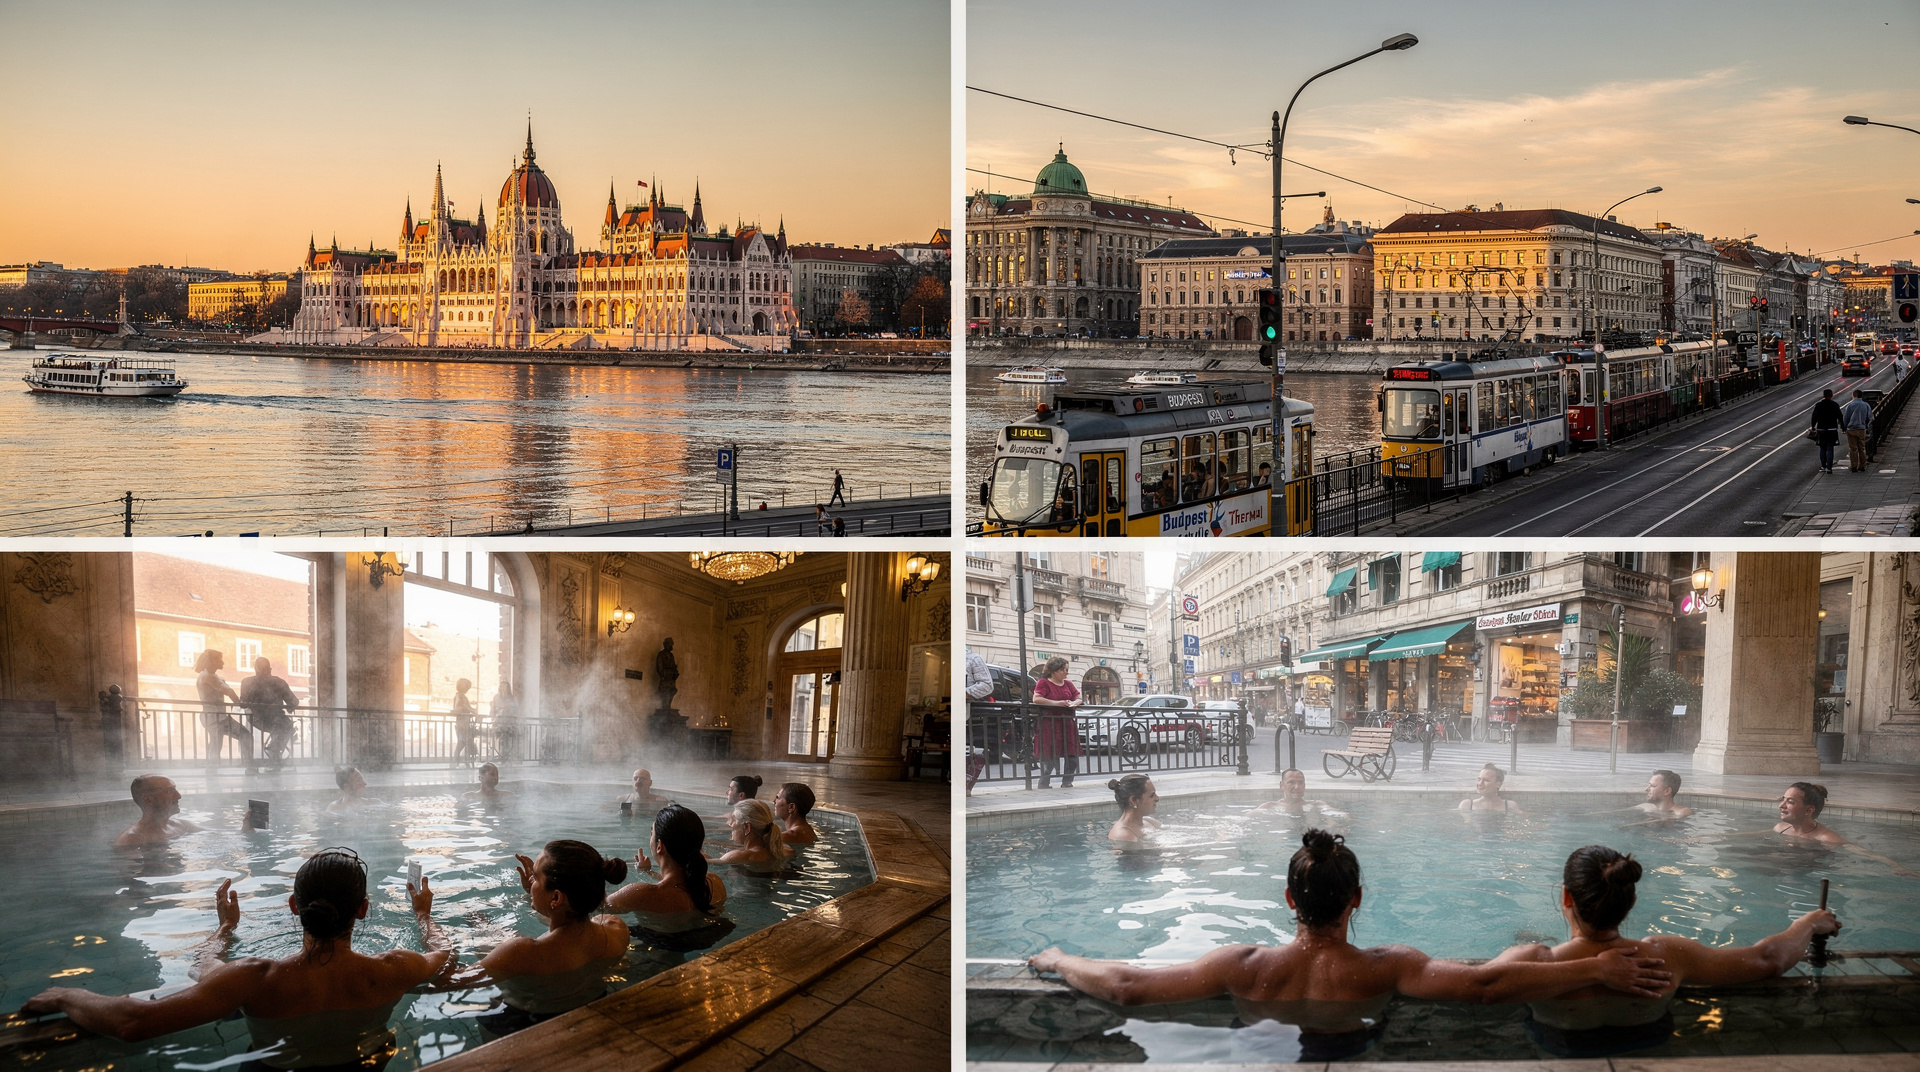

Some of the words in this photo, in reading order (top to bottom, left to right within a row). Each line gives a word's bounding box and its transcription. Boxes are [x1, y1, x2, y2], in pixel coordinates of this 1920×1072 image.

[721, 453, 729, 466] P
[1163, 510, 1208, 532] Budpest
[1187, 636, 1195, 646] P
